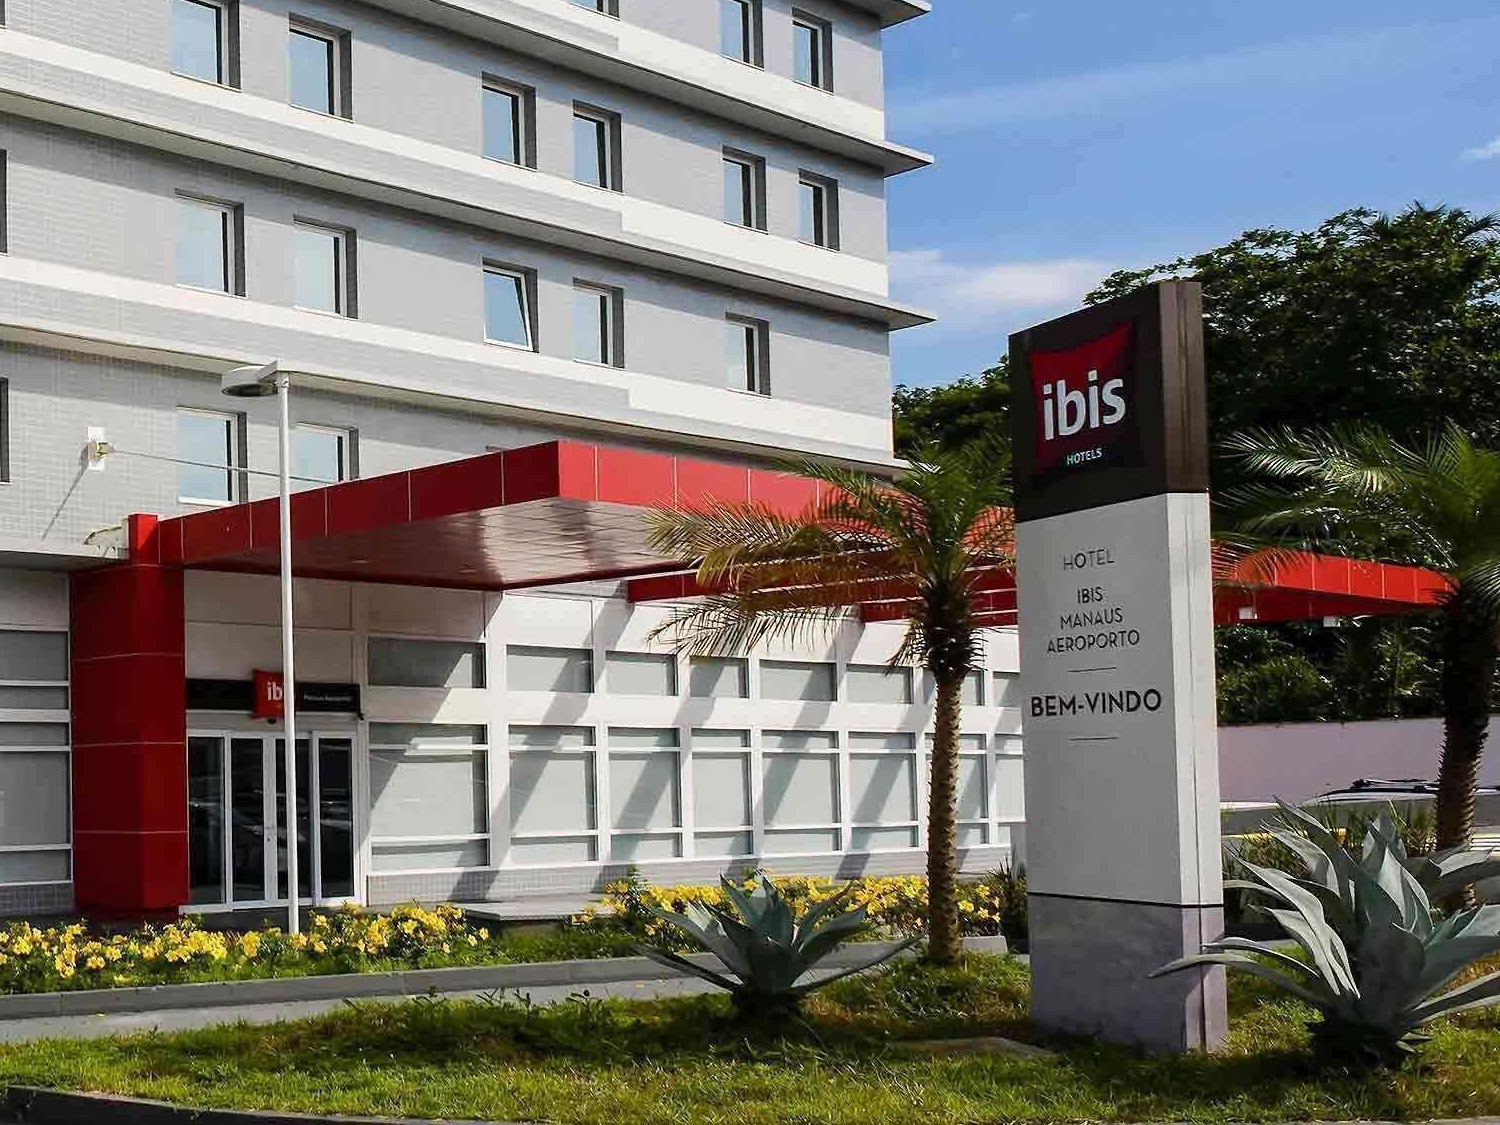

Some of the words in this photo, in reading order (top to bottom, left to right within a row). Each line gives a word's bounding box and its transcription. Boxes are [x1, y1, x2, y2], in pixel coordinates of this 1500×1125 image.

[1043, 369, 1126, 440] ibis
[1066, 447, 1103, 465] HOTELS
[1062, 548, 1116, 571] HOTEL
[1077, 586, 1104, 604] IBIS
[1060, 607, 1124, 630] MANAUS
[1046, 629, 1141, 653] AEROPORTO
[267, 681, 284, 701] ib
[1030, 688, 1162, 717] BEM-VINDO
